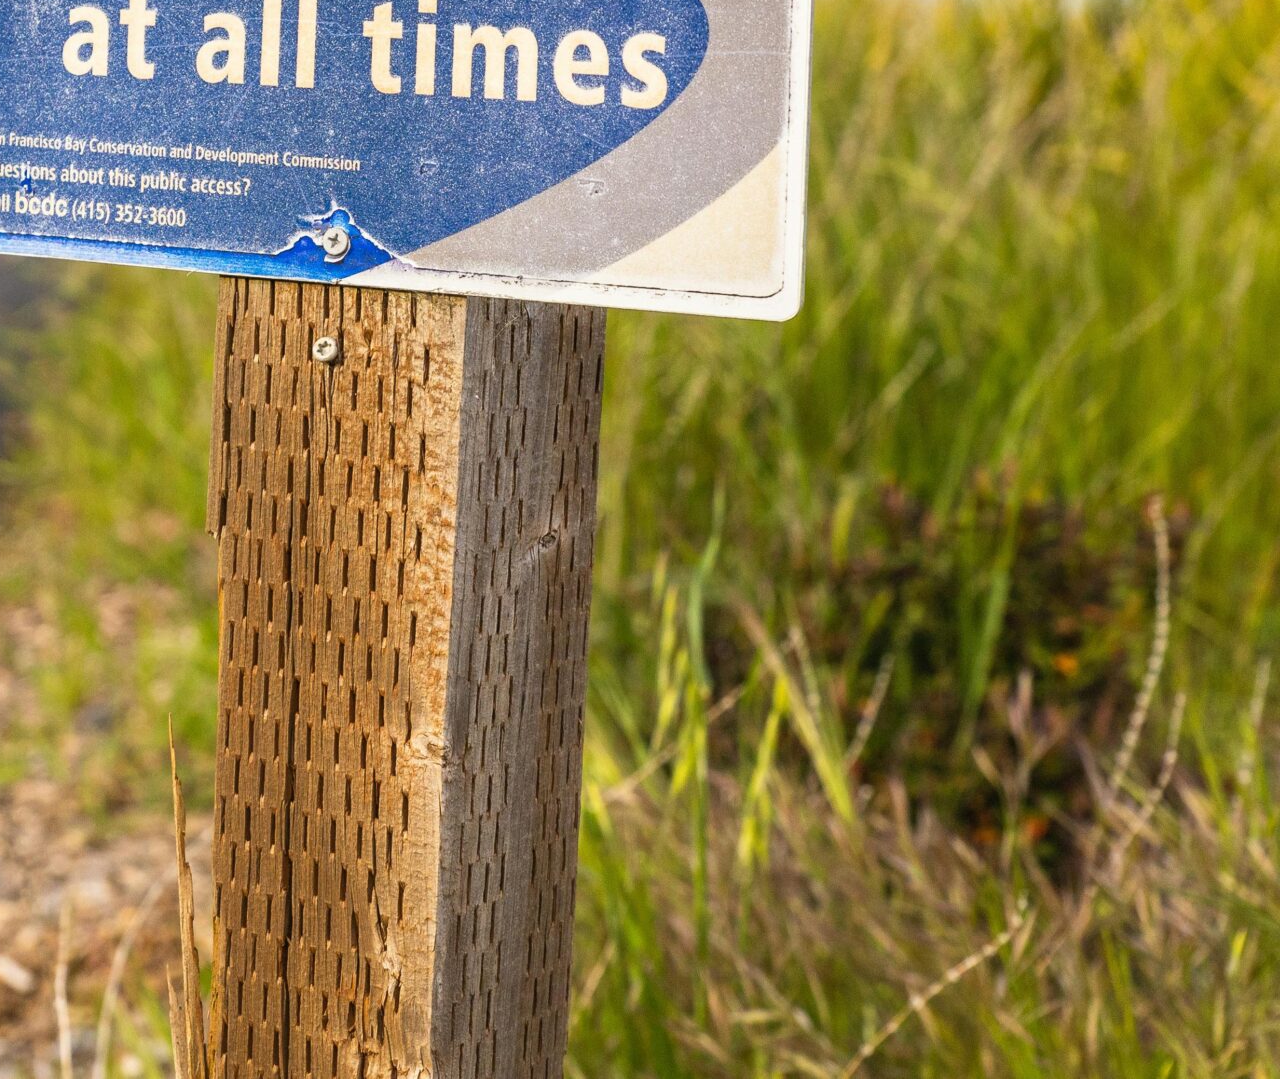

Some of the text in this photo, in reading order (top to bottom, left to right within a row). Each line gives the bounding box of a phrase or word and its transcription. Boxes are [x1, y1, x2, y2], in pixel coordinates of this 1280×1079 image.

[9, 133, 61, 150] Francisco
[65, 138, 86, 154] Bay
[89, 139, 166, 159] Conservation
[170, 144, 192, 159] and
[196, 146, 279, 166] Development
[283, 152, 360, 171] Commission
[61, 167, 104, 185] about
[108, 170, 136, 186] this
[140, 172, 186, 192] public
[192, 178, 251, 196] access?
[15, 191, 67, 217] bcdc
[72, 199, 111, 223] (415)
[115, 206, 186, 227] 352-3600
